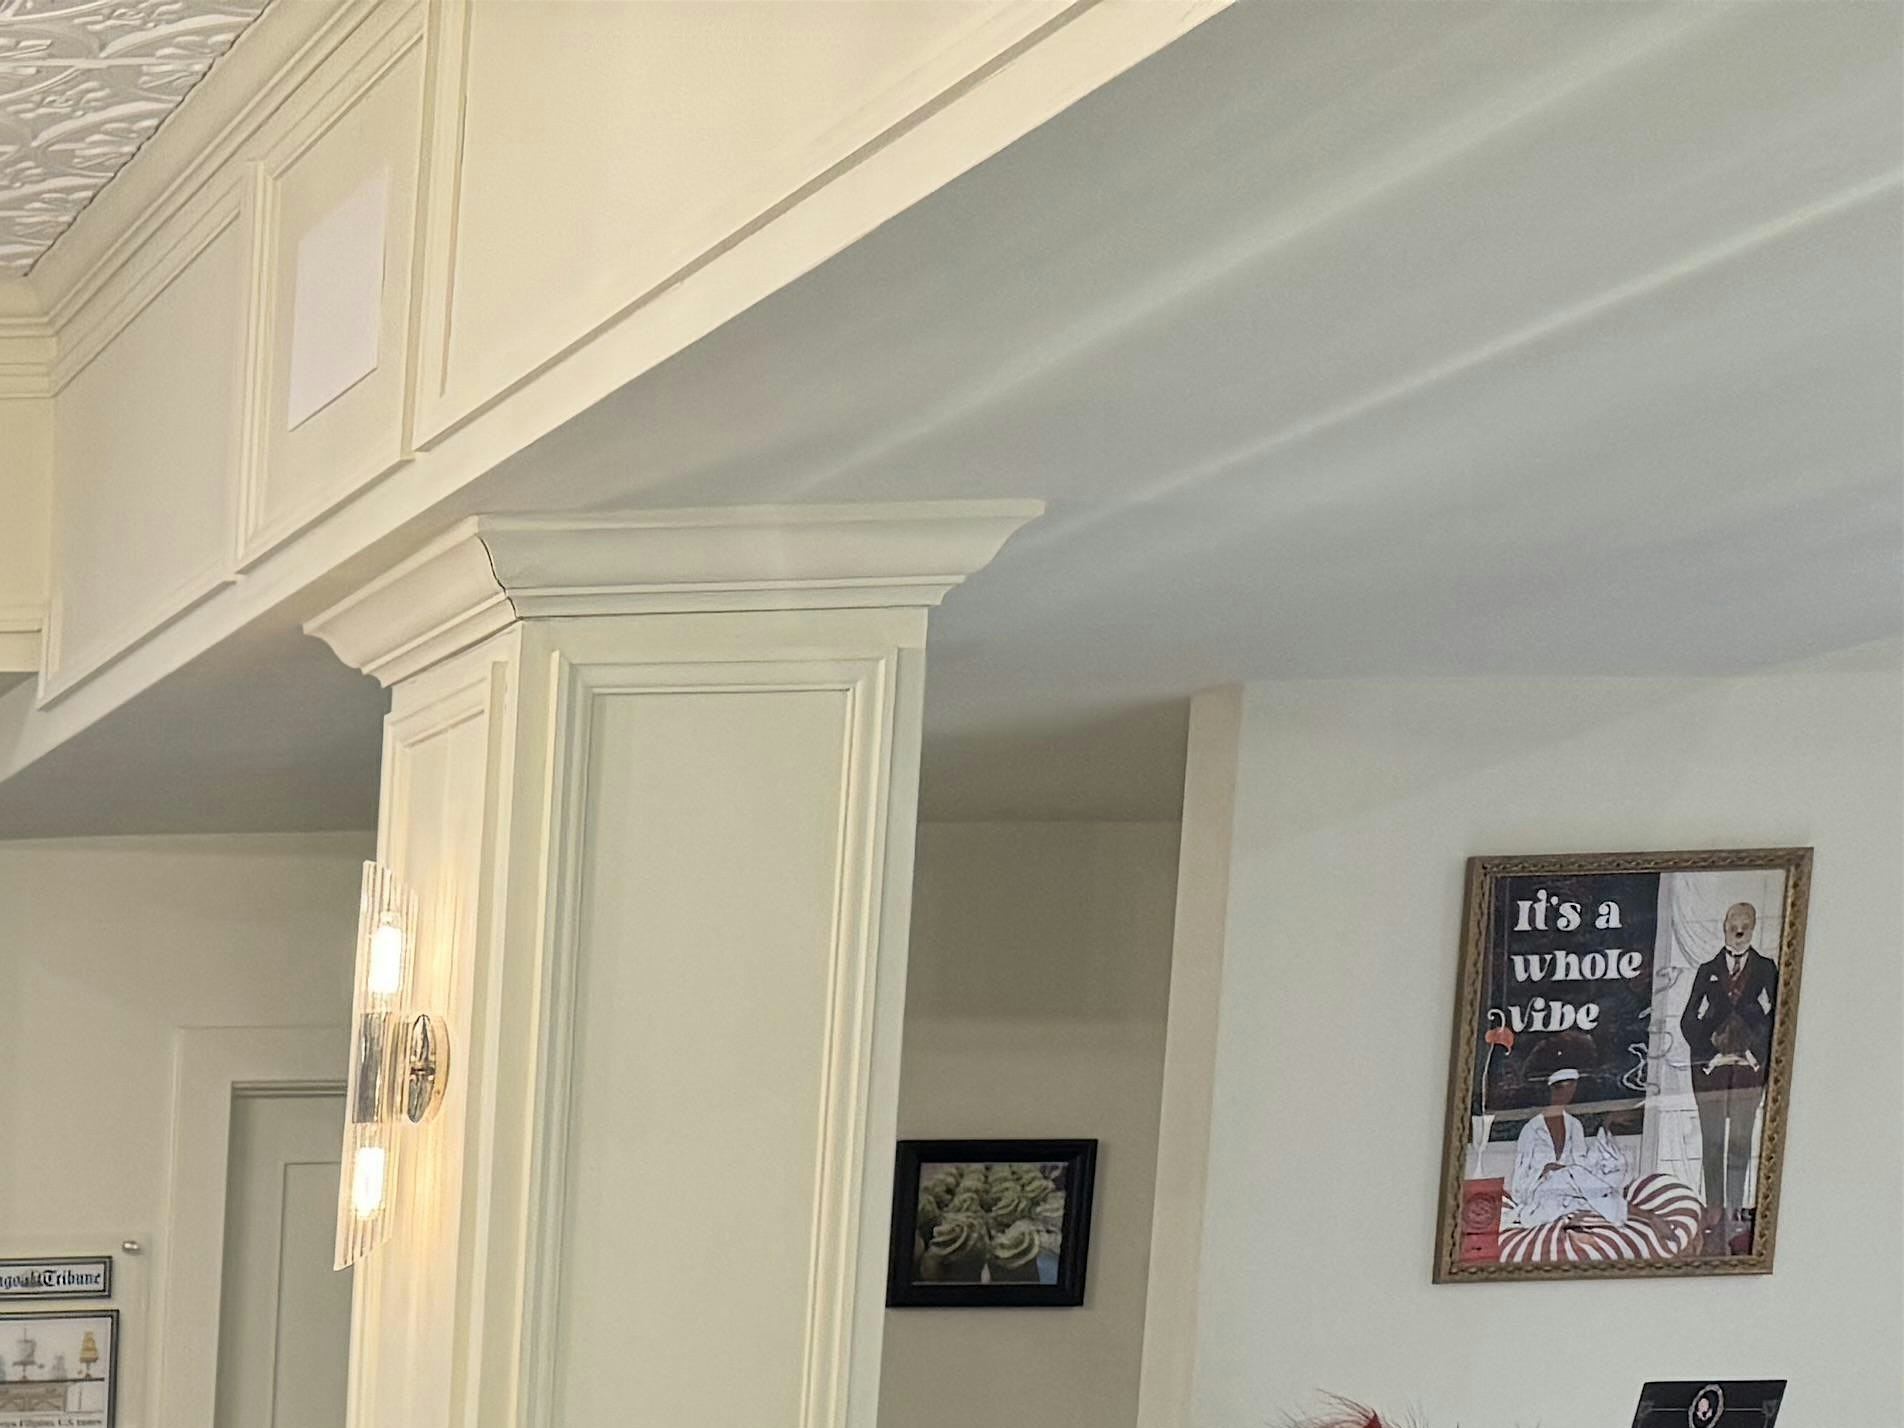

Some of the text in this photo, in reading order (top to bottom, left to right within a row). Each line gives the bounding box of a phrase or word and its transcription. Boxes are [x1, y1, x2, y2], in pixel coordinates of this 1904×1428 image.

[1512, 889, 1623, 931] It's a
[1510, 948, 1644, 985] whole
[1508, 998, 1600, 1033] vibe
[42, 1270, 101, 1287] Tribune
